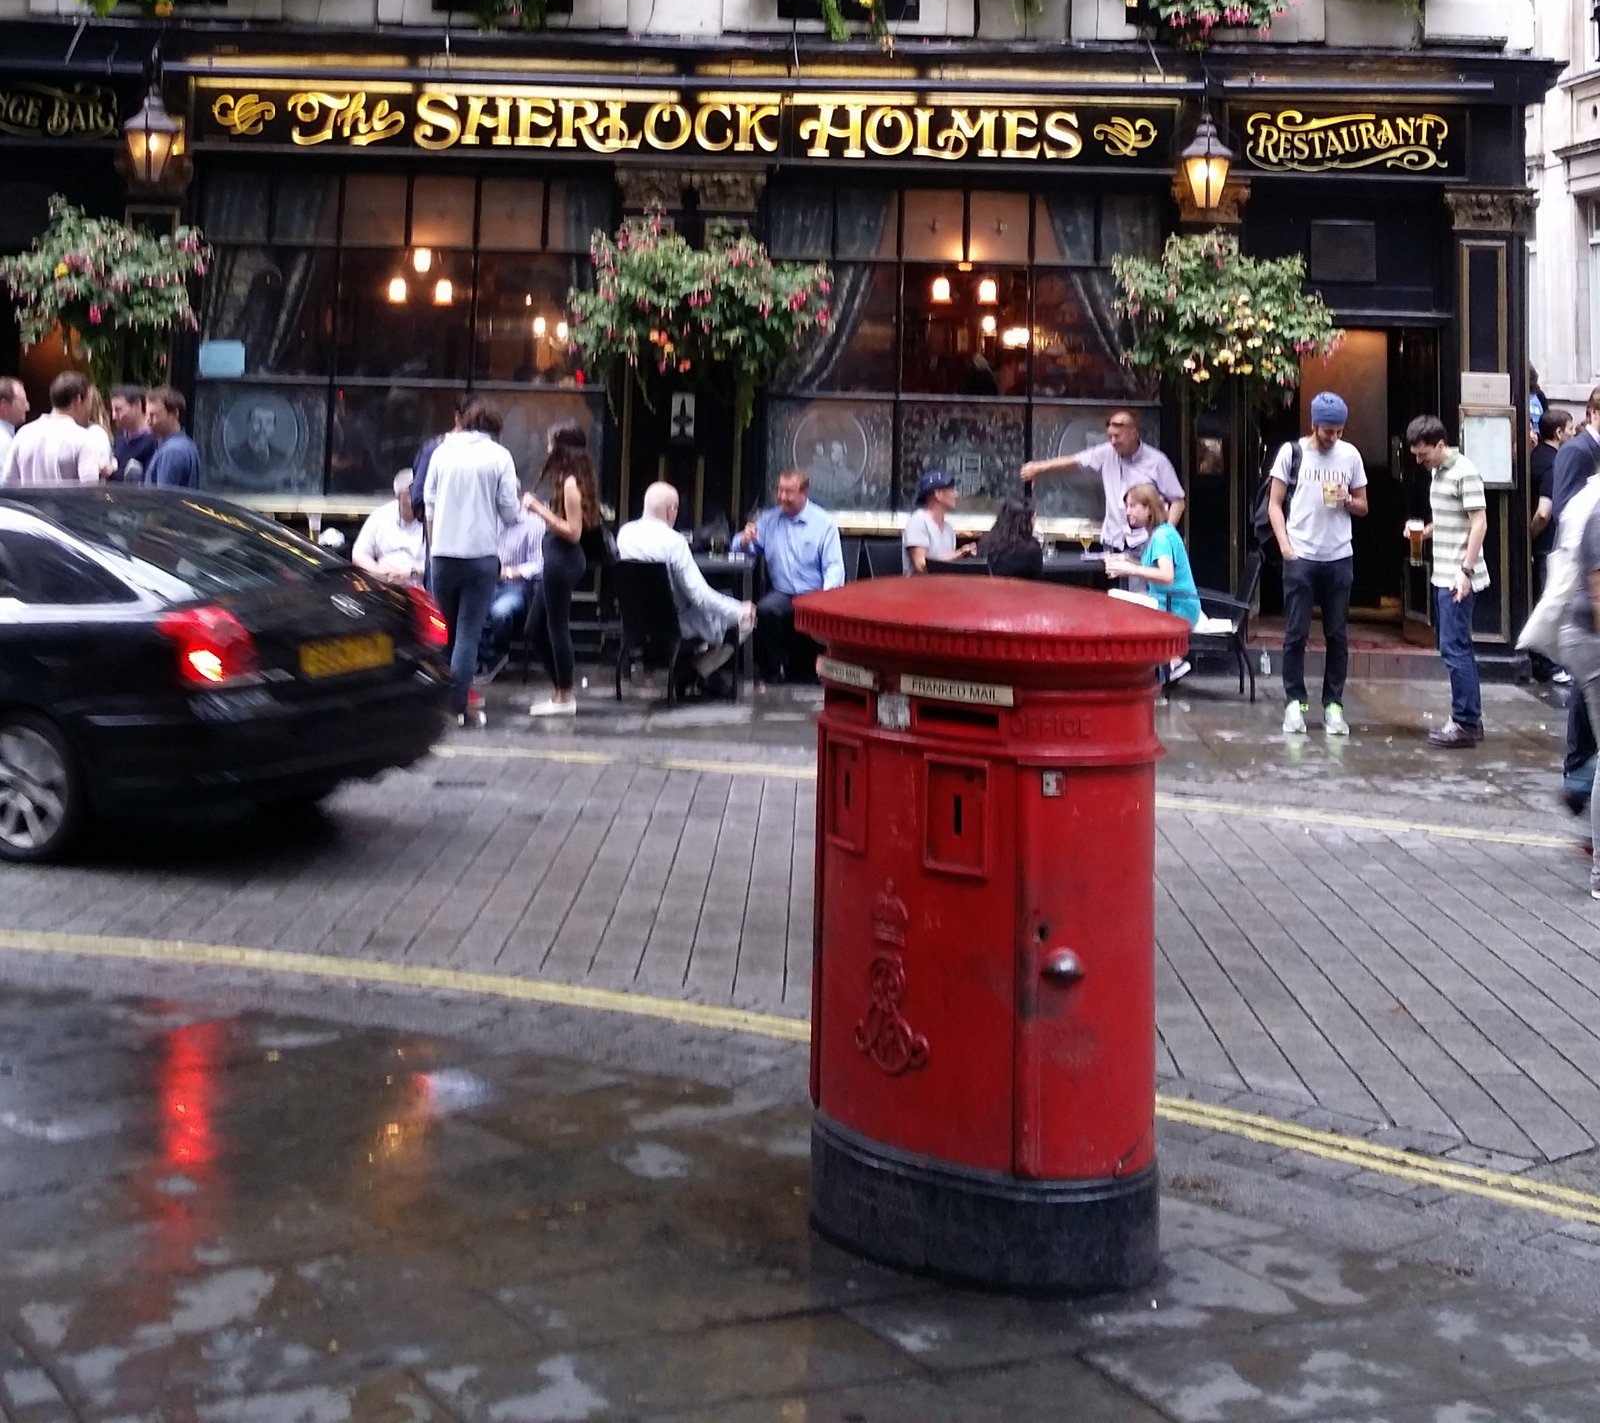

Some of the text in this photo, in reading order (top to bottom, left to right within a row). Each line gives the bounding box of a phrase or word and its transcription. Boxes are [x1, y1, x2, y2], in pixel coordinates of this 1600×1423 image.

[47, 97, 115, 136] BAR
[288, 91, 1083, 160] The SHERLOCK HOLMES
[1257, 117, 1434, 163] RESTAURANT
[911, 679, 998, 703] FRANKED MAIL
[1009, 713, 1092, 739] OFFICE
